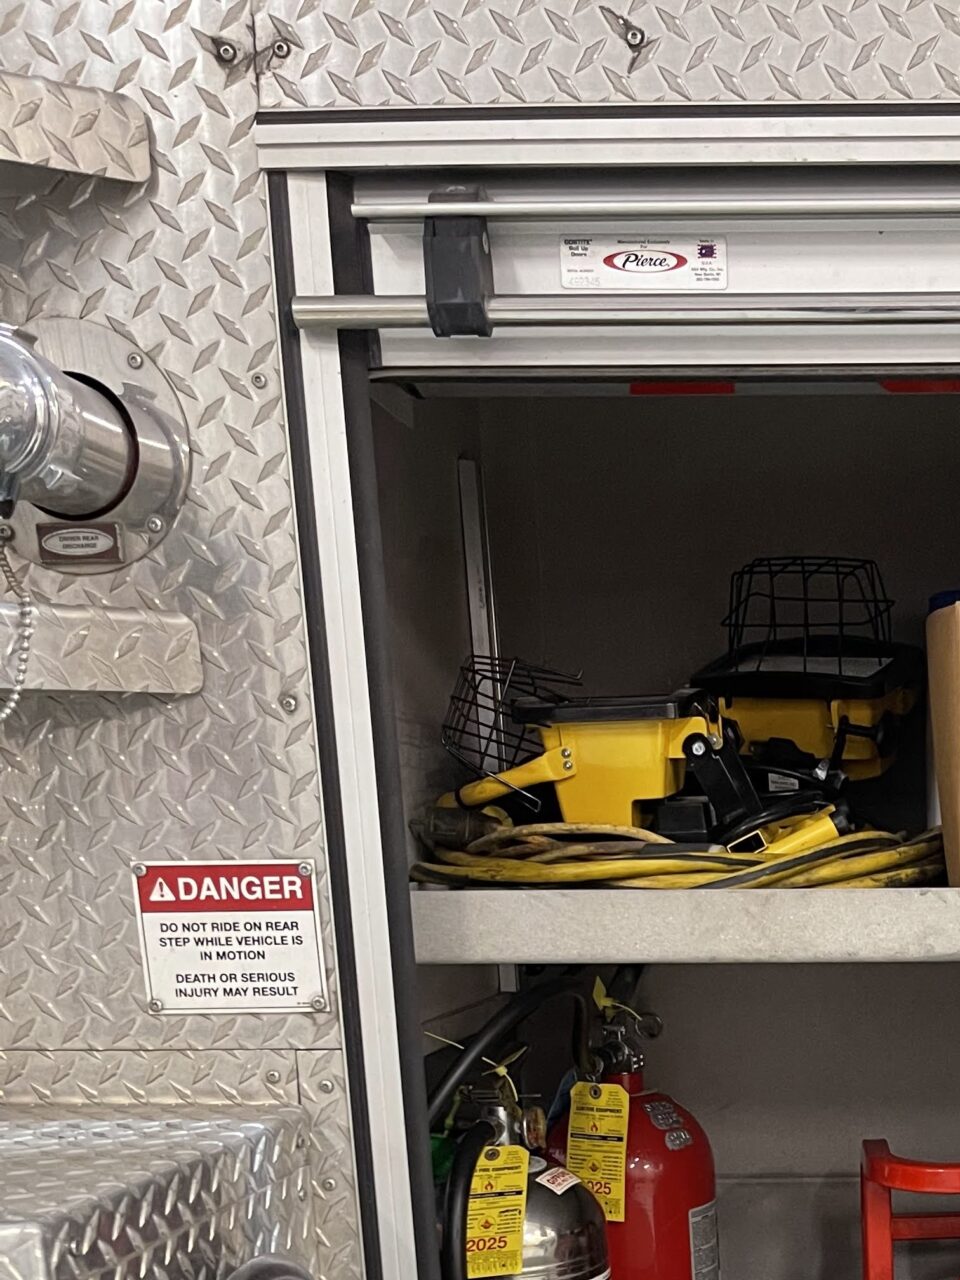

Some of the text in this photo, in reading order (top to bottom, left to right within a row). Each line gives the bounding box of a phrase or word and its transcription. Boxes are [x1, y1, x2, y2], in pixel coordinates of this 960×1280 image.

[622, 253, 667, 269] Pierce
[177, 875, 303, 901] DANGER
[160, 921, 299, 933] DO NOT RIDE ON REAR
[159, 935, 303, 947] STEP WHILE VEHICLE IS
[200, 950, 266, 961] IN MOTION
[176, 972, 296, 984] DEATH OR SERIOUS
[175, 986, 299, 998] INJURY MAY RESULT
[465, 1236, 508, 1252] 2025
